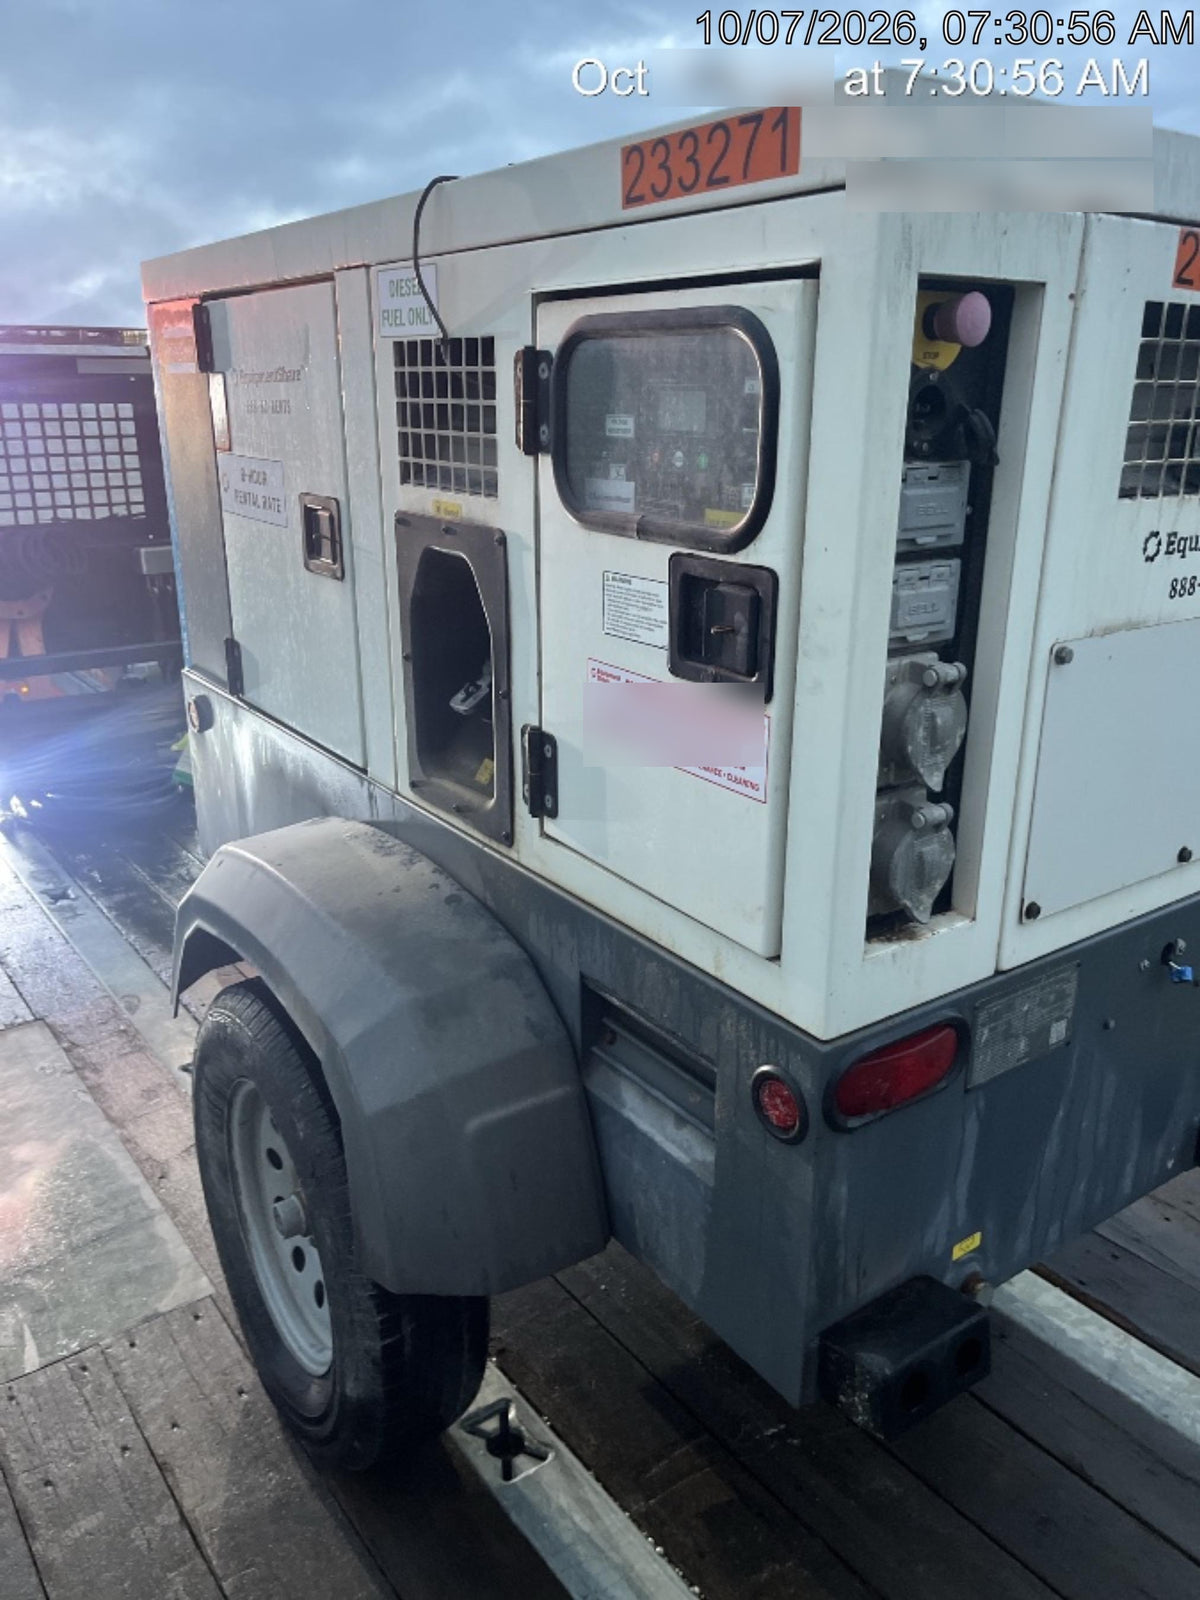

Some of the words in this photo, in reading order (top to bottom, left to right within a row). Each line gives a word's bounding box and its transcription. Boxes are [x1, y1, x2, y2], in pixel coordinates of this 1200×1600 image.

[625, 107, 788, 205] 233271
[1175, 230, 1200, 286] 2
[381, 308, 405, 328] FUEL
